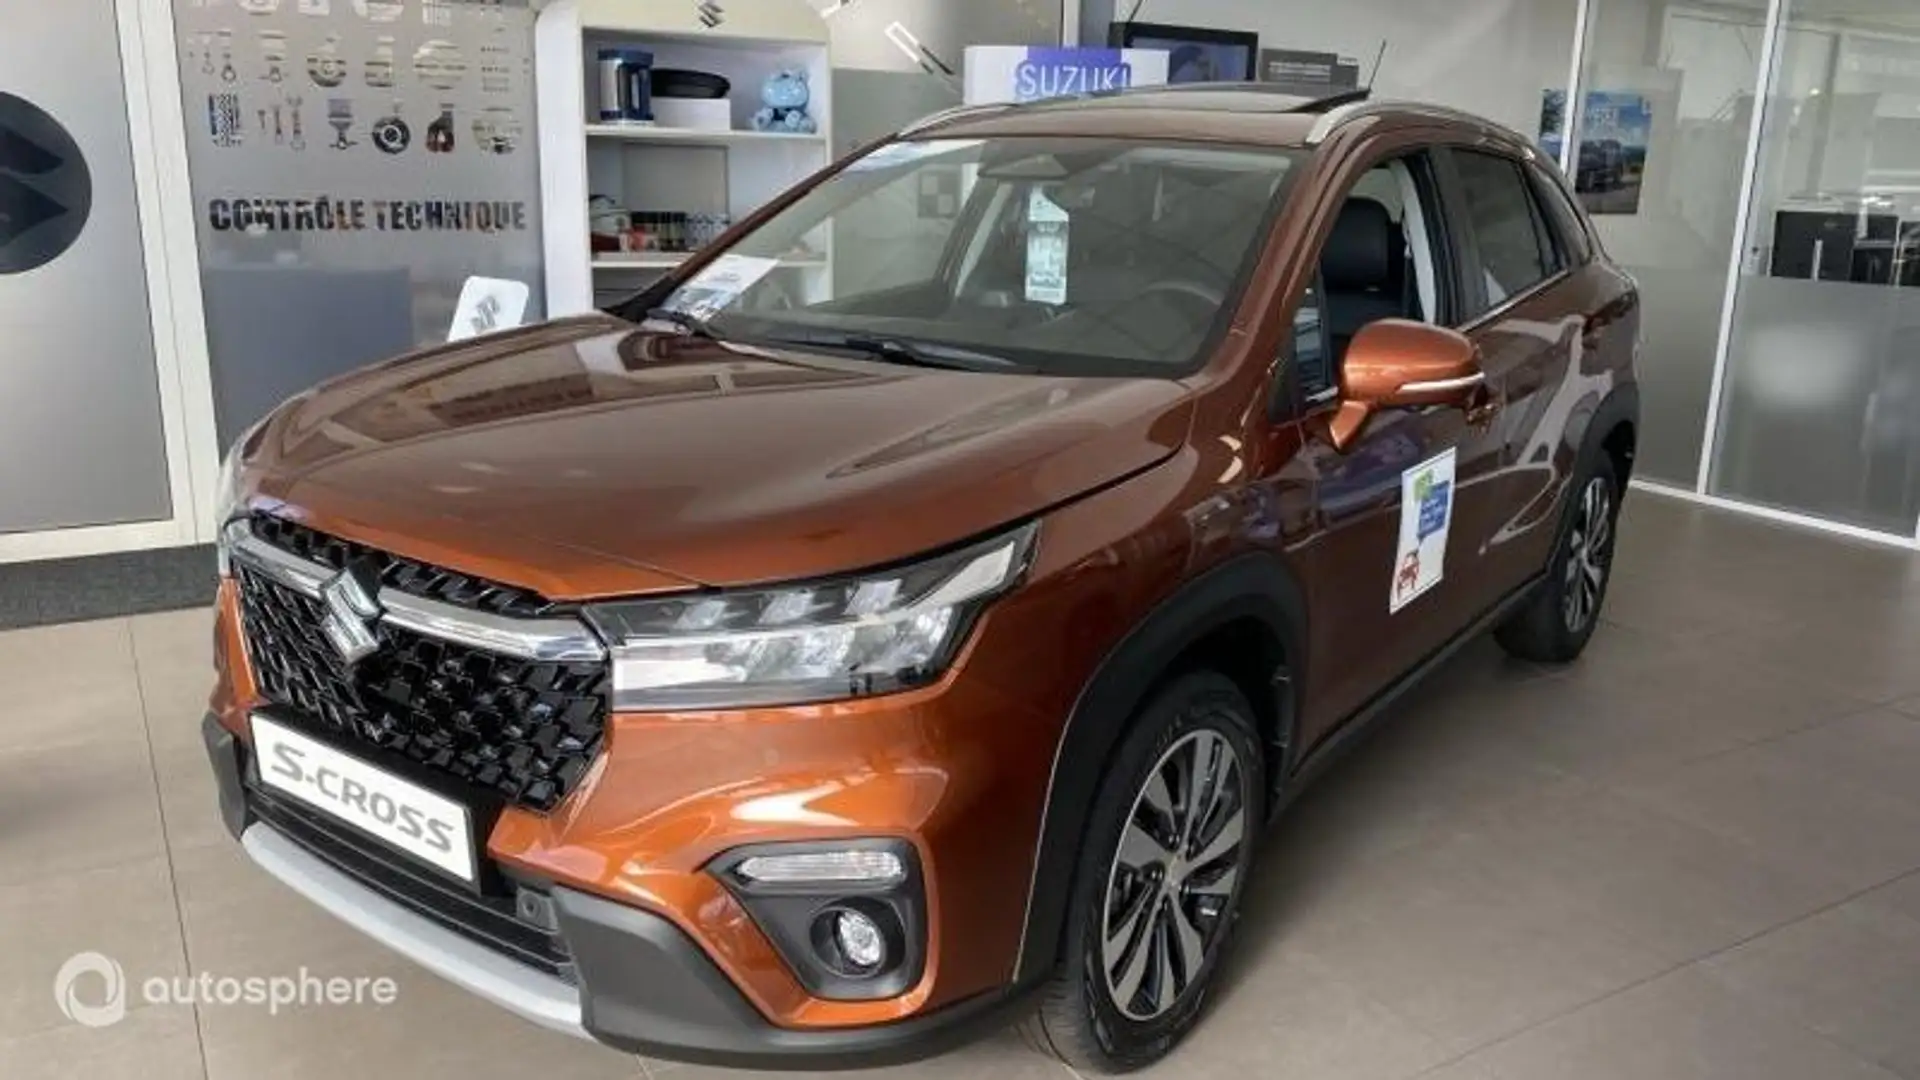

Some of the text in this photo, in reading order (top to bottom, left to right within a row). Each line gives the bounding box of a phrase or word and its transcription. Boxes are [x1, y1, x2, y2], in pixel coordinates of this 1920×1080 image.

[1020, 63, 1128, 96] SUZUKI
[208, 196, 527, 233] CONTRÔLE TECHNIQUE
